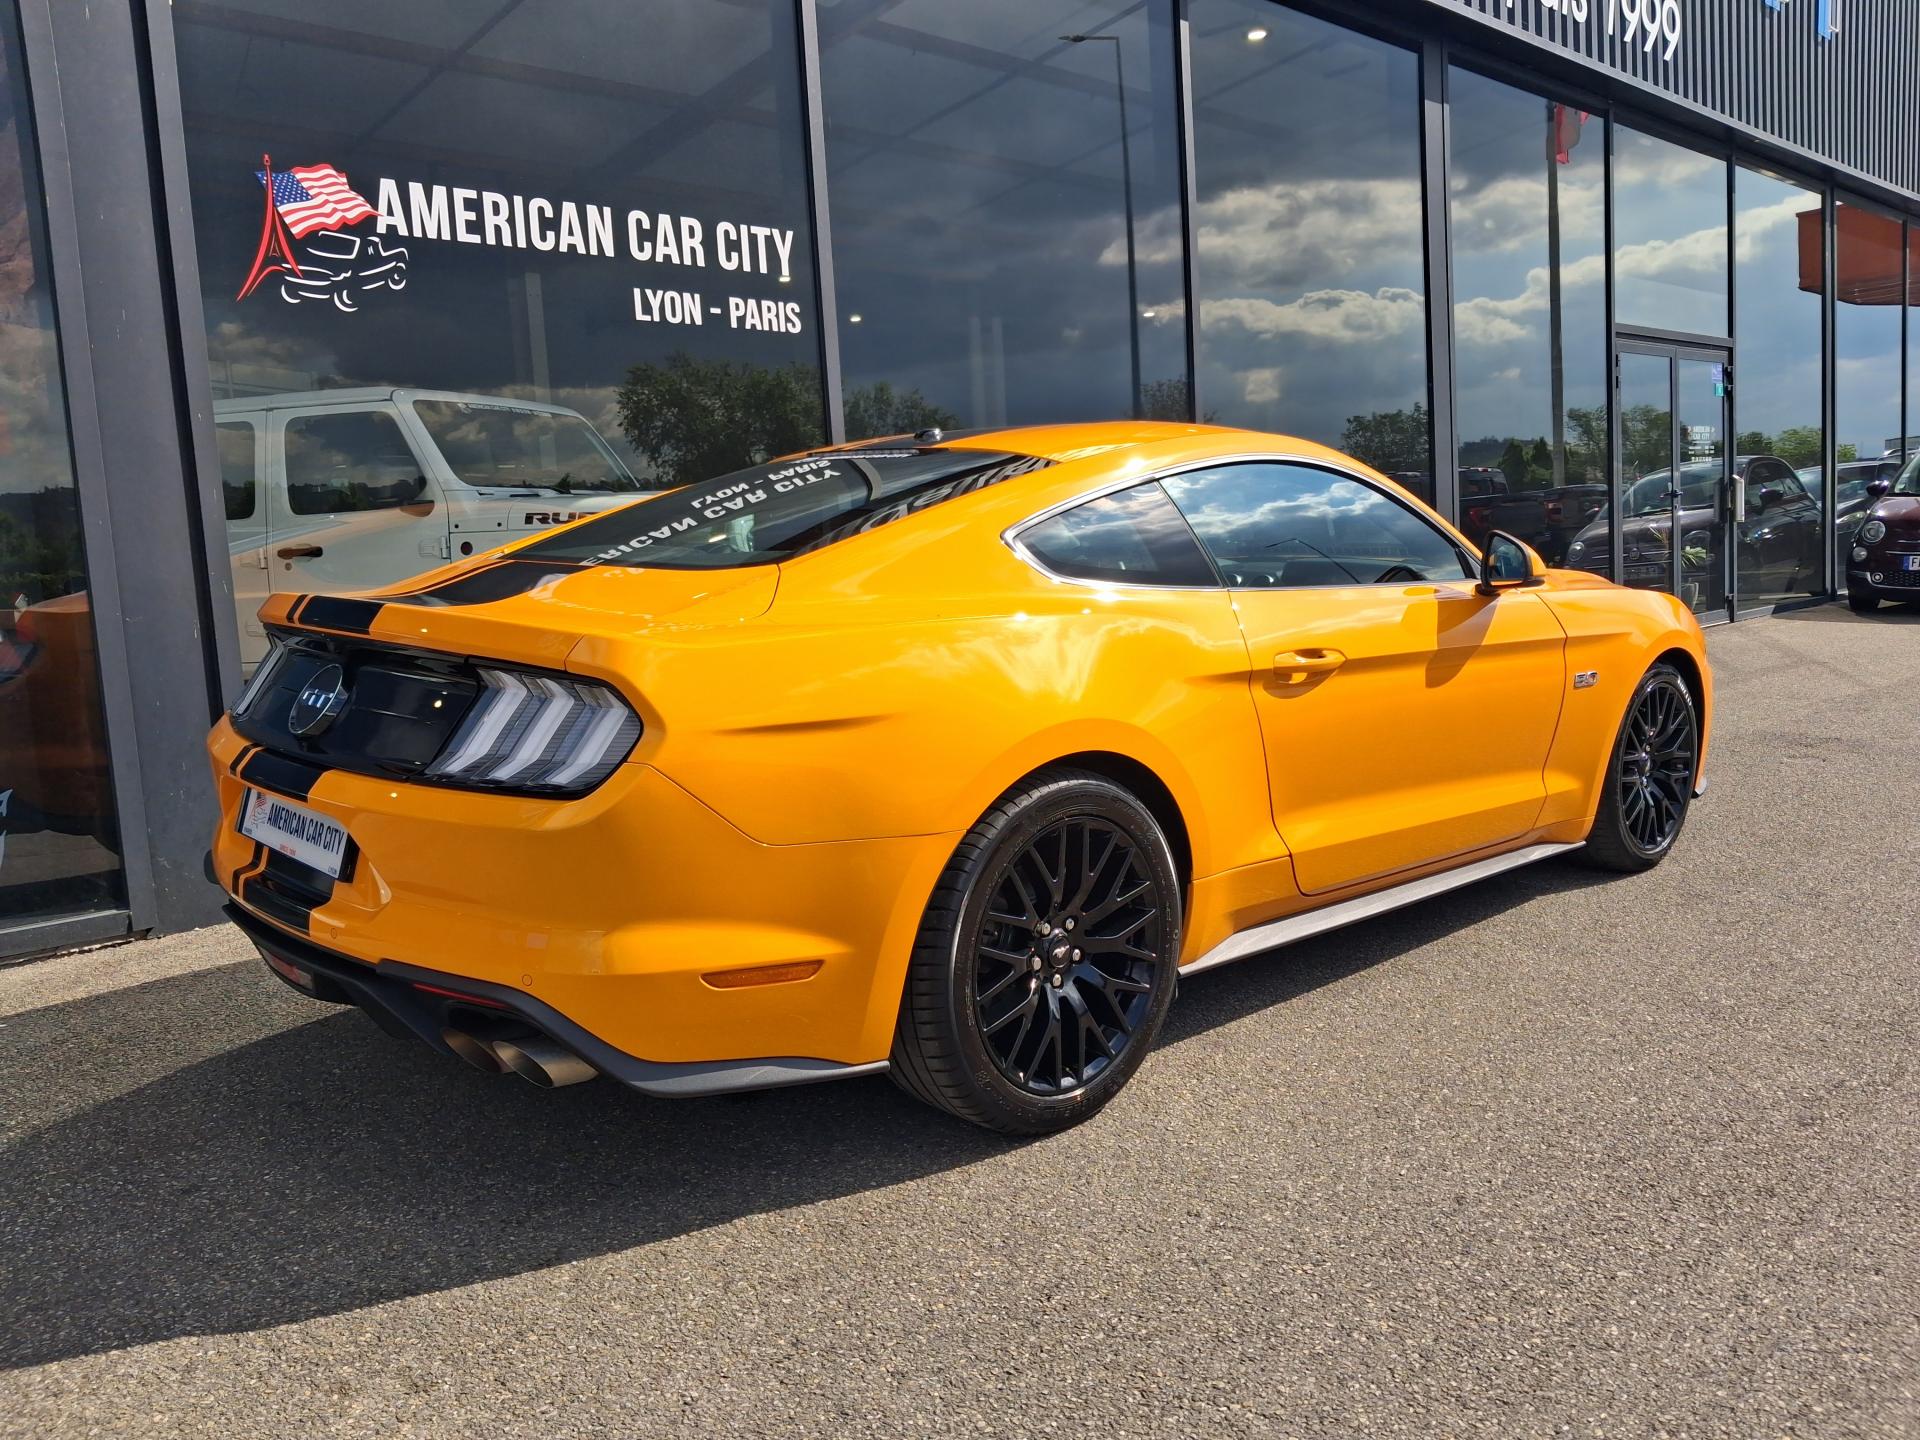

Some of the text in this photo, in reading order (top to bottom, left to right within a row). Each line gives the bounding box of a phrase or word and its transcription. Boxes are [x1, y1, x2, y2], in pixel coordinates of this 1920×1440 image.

[1607, 0, 1681, 62] 1999
[377, 178, 794, 276] AMERICAN CAR CITY
[633, 287, 701, 325] LYON
[730, 296, 801, 334] PARIS
[524, 511, 600, 525] RU
[267, 803, 308, 840] AMERICAN
[306, 818, 325, 847] CAR
[323, 825, 345, 855] CITY
